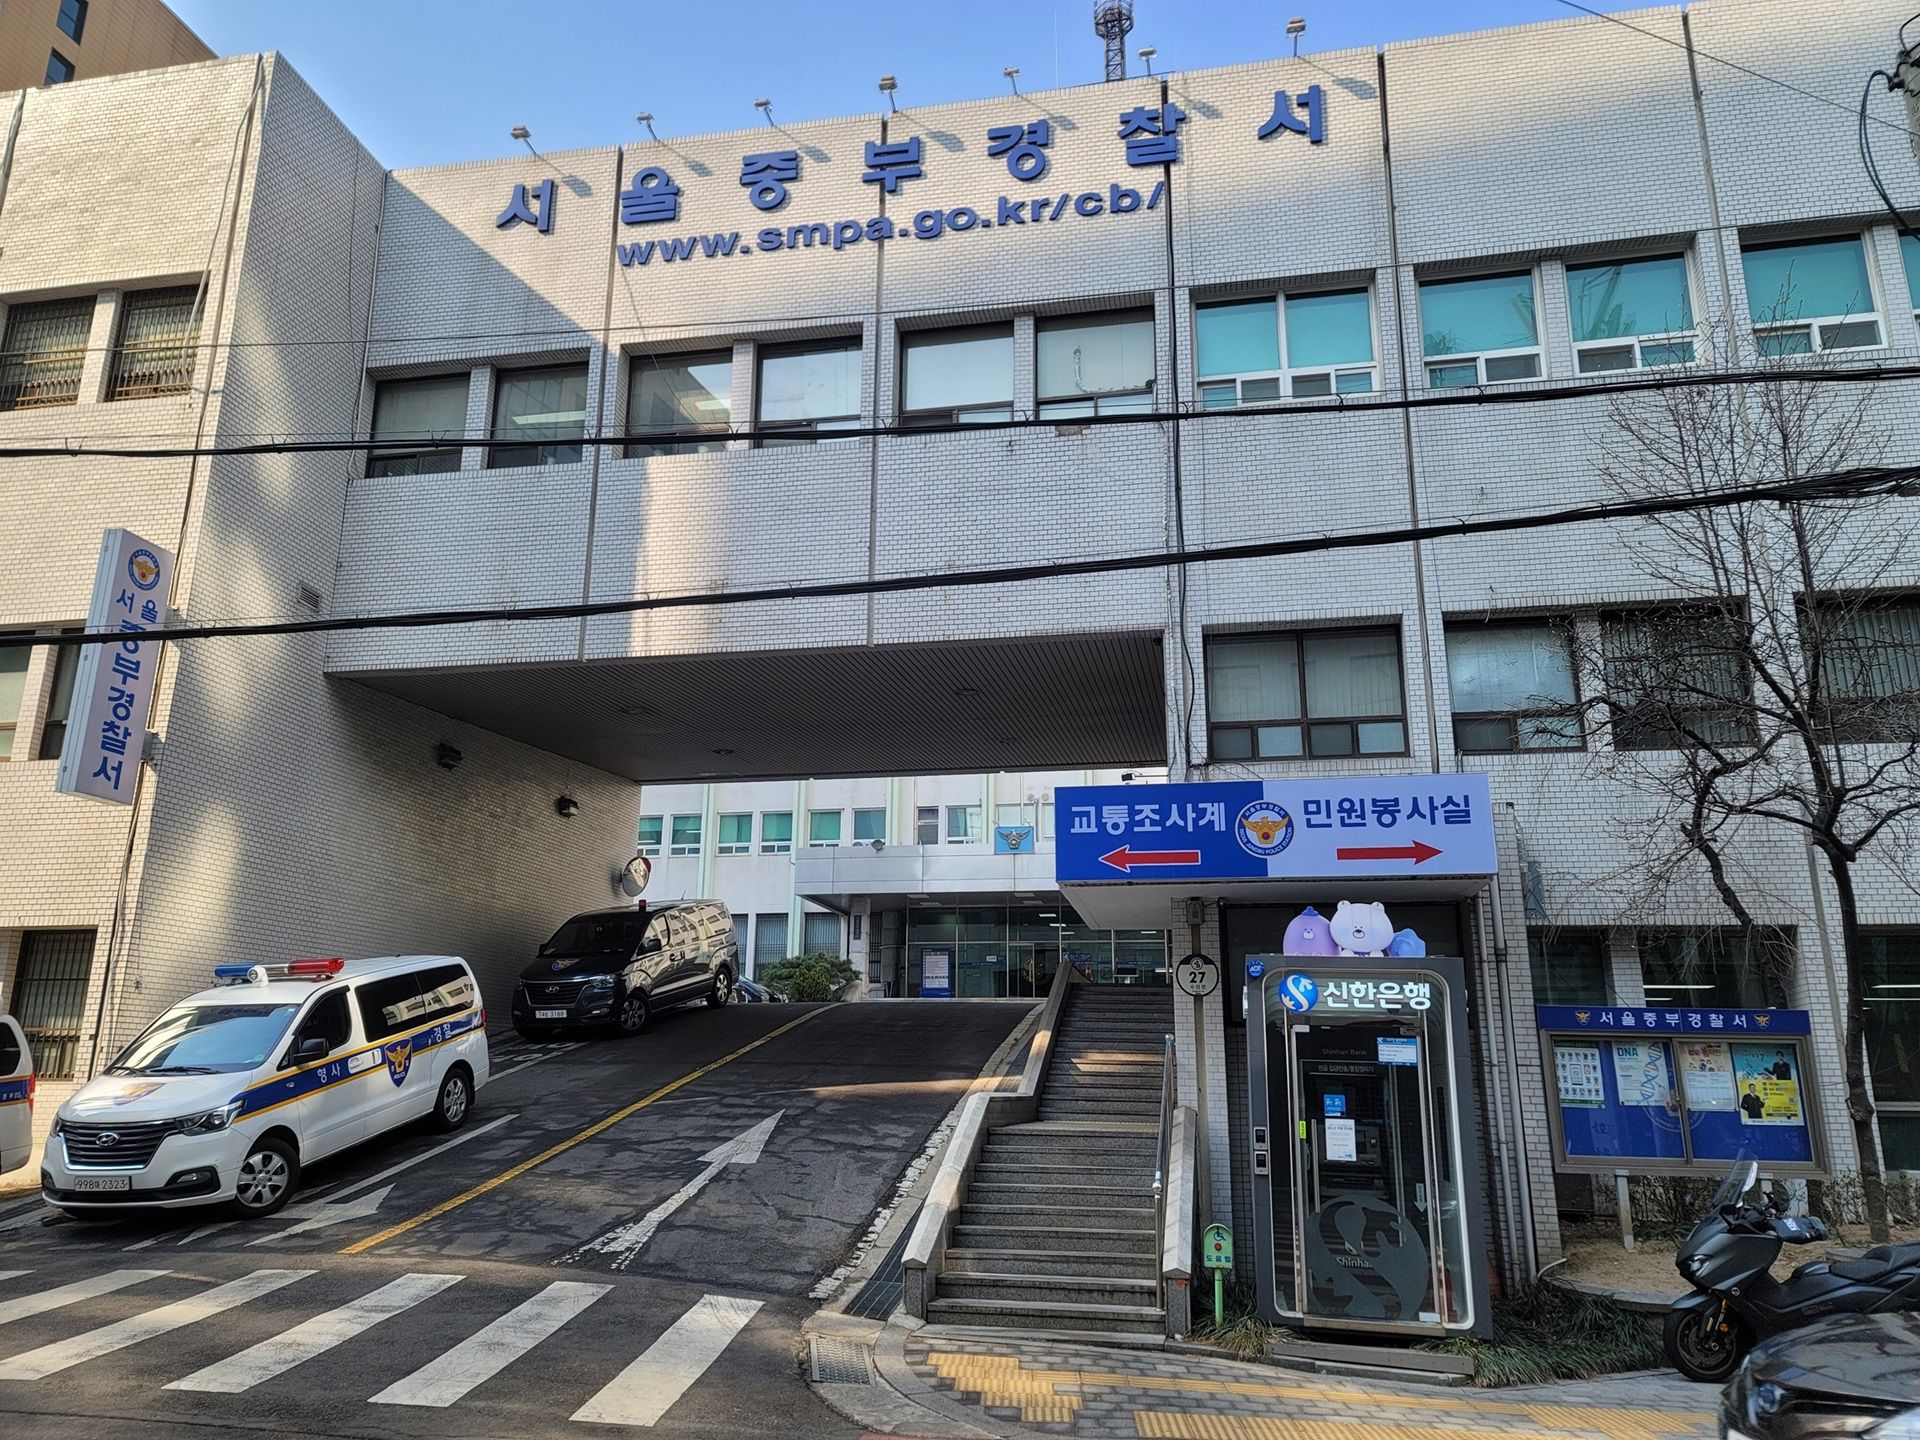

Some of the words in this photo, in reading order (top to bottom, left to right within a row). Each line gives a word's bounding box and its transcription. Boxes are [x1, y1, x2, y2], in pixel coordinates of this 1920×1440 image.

[496, 85, 1324, 233] 서울중부경찰서
[617, 181, 1165, 266] www.smpa.go.kr/cb/
[1070, 801, 1227, 835] 교통조사계
[1303, 794, 1472, 829] 민원봉사실
[1189, 971, 1206, 984] 27
[1322, 981, 1431, 1010] 신한은행
[1600, 1011, 1747, 1029] 서울중부경찰서
[433, 1022, 452, 1043] 경찰
[1617, 1047, 1639, 1058] DNA
[316, 1062, 341, 1083] 형사
[102, 1179, 126, 1190] 2323
